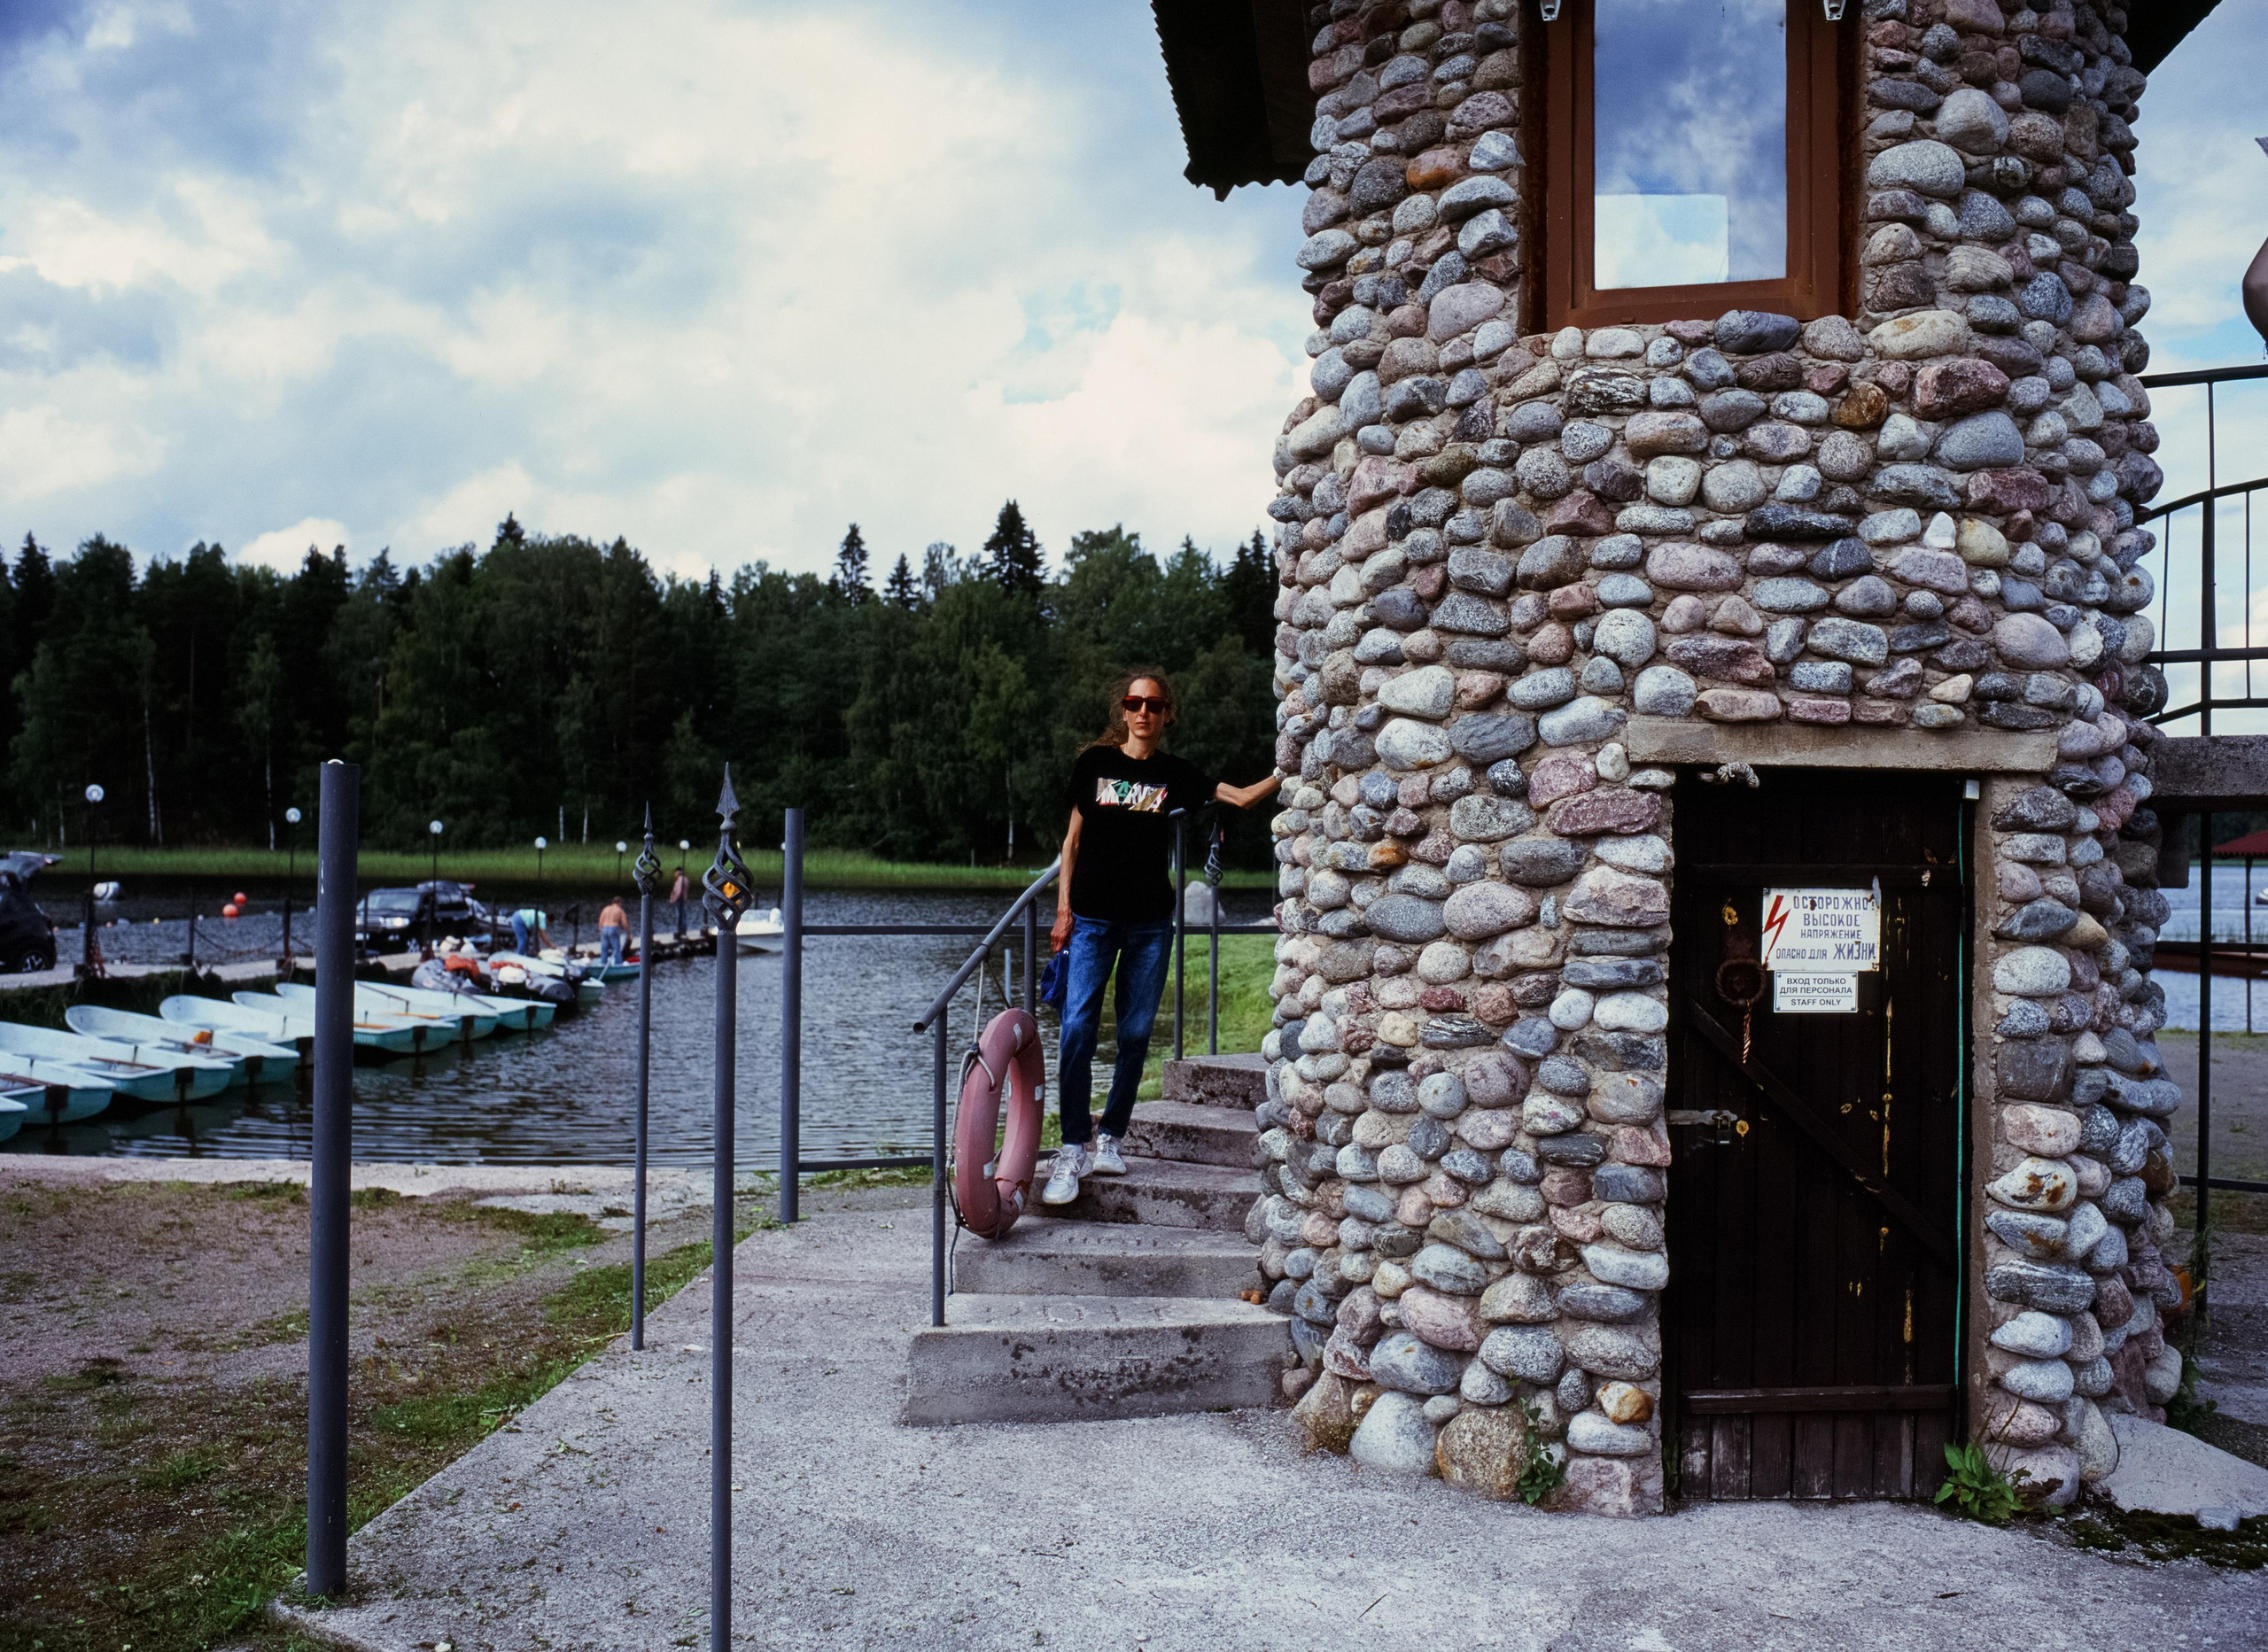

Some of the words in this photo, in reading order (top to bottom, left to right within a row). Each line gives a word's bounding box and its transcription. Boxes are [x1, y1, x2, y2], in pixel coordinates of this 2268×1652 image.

[1803, 914, 1860, 927] ВЫСОКОЕ
[1800, 929, 1862, 939] НАПРЯЖЕНИЕ
[1775, 948, 1806, 959] ОПАСНО
[1807, 949, 1828, 960] ДЛЯ
[1786, 977, 1810, 986] ВХОД
